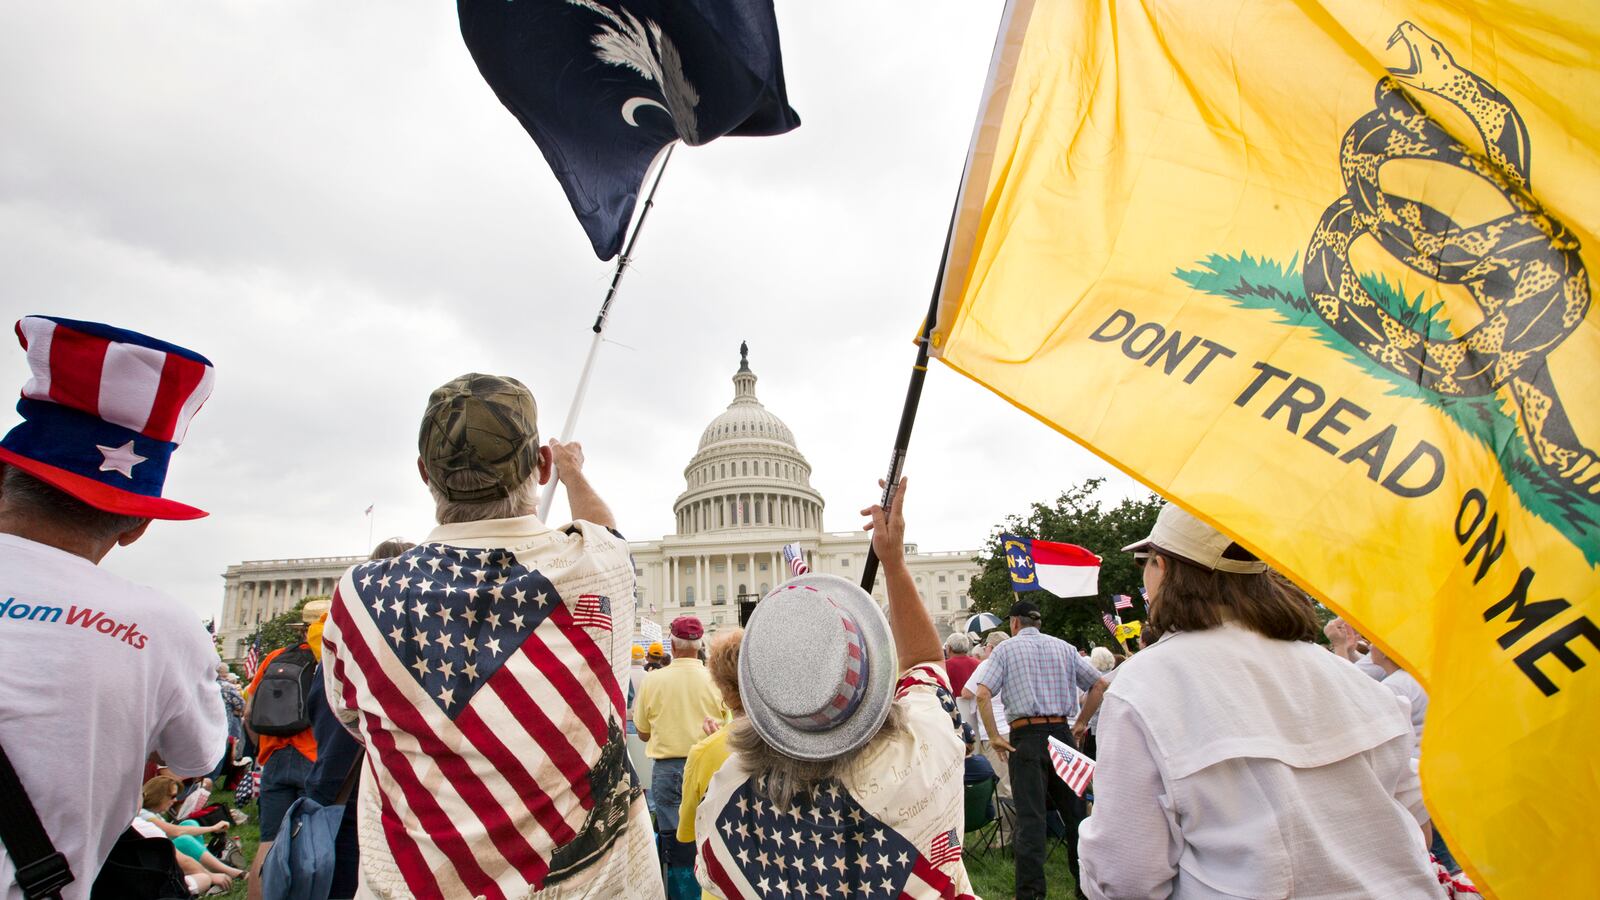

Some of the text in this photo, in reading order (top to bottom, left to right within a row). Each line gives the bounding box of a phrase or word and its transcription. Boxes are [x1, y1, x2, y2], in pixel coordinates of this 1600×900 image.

[1089, 309, 1600, 697] DONT TREAD ON ME
